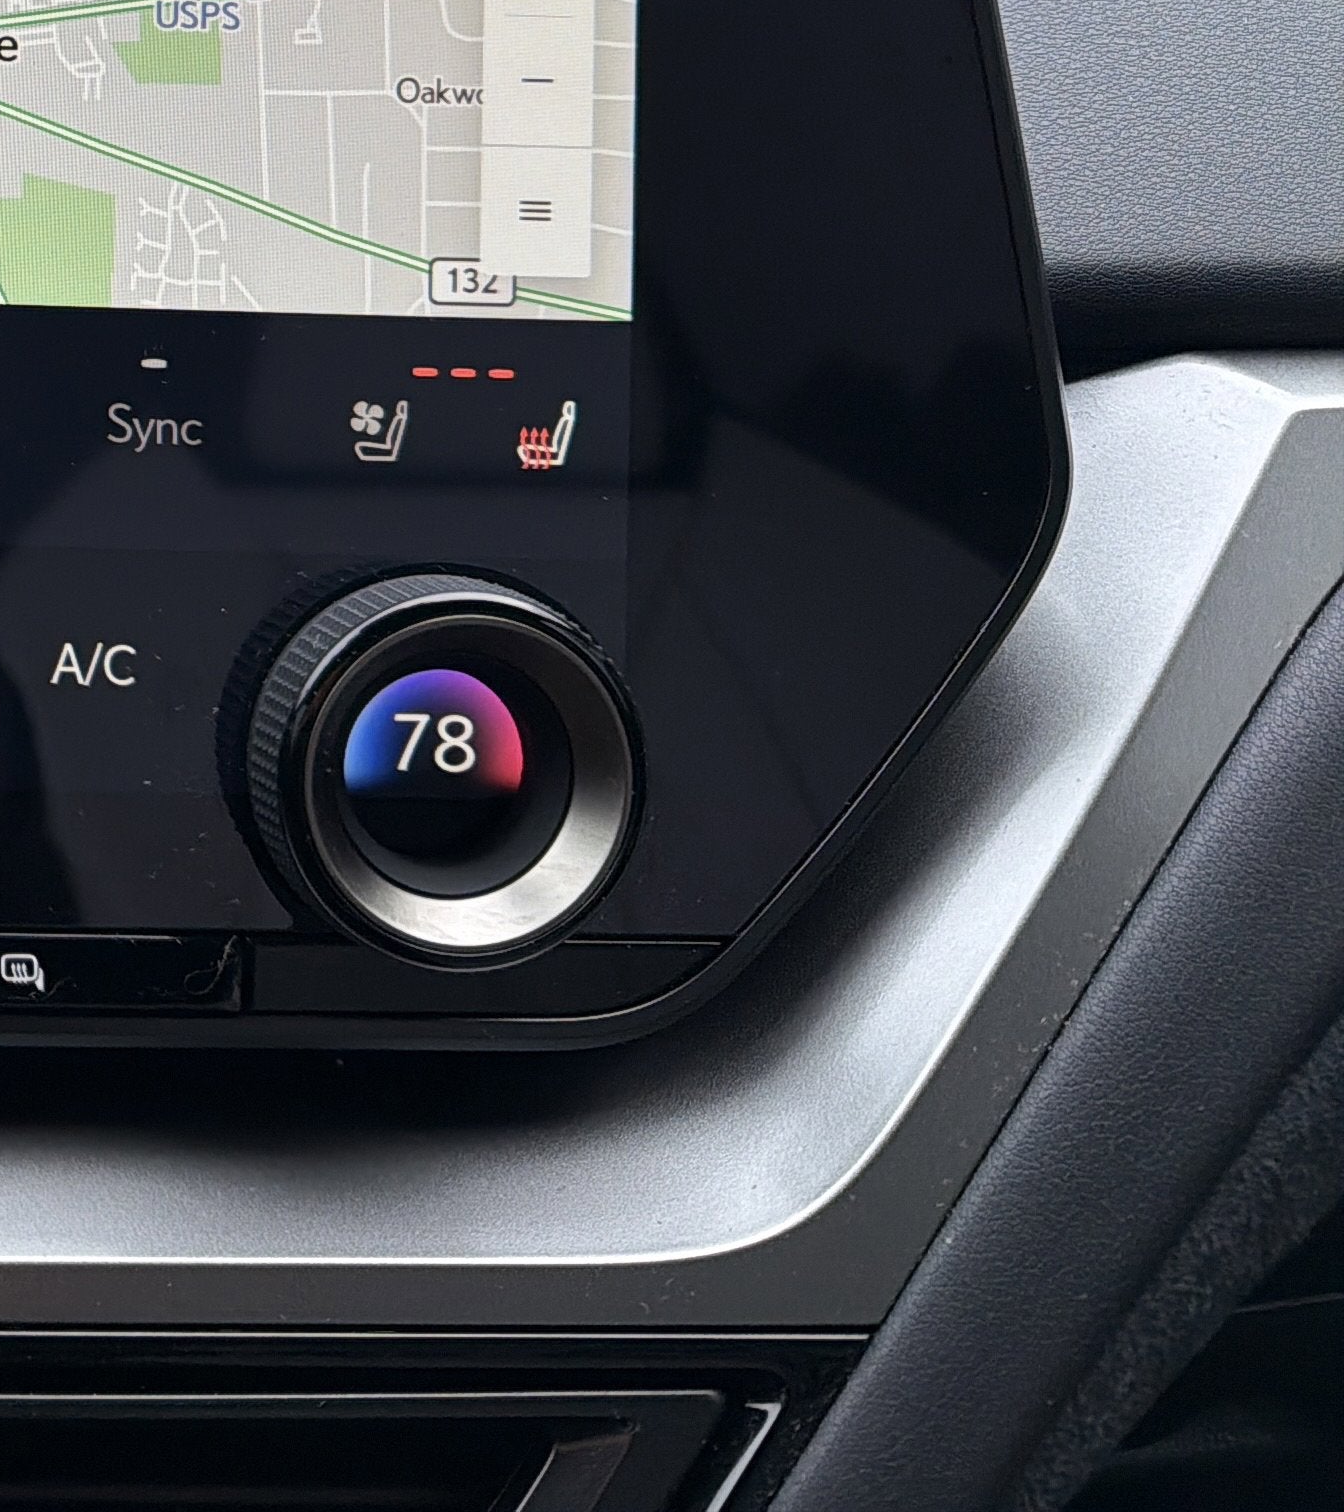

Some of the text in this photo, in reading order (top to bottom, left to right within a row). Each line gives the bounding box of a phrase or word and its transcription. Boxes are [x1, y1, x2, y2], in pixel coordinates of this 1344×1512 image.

[155, 0, 241, 30] USPS
[106, 403, 203, 452] Sync
[50, 643, 137, 689] A/C
[393, 714, 477, 773] 78
